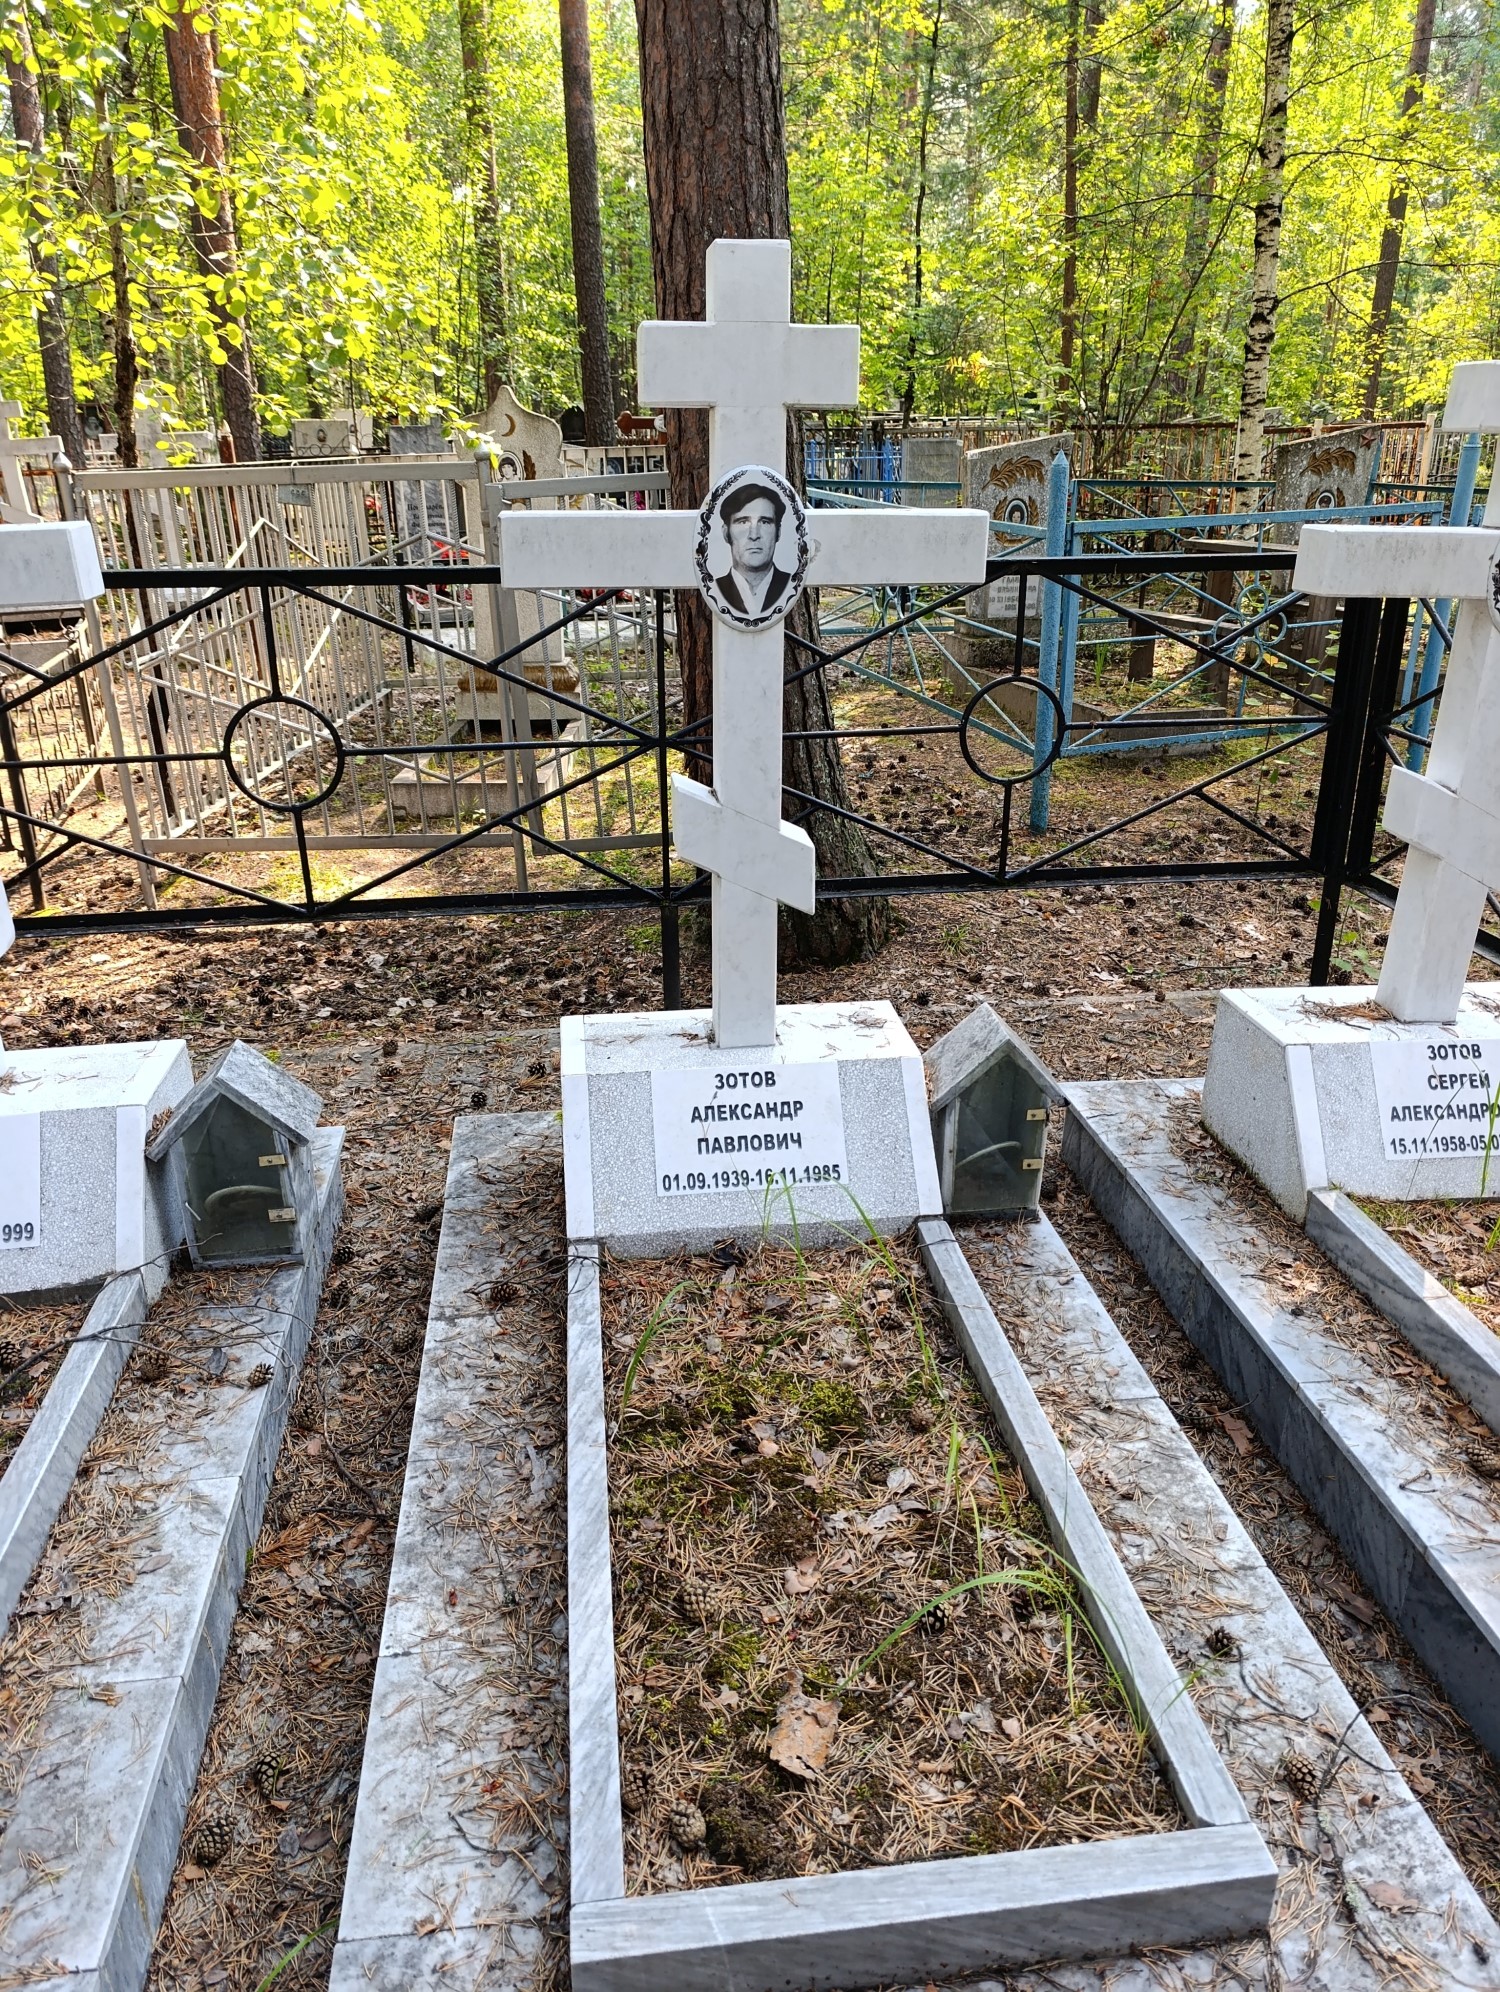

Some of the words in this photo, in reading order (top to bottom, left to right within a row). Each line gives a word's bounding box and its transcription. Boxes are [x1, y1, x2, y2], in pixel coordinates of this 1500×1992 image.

[1427, 1043, 1482, 1061] ЗОТОВ
[714, 1070, 776, 1090] ЗОТОВ
[1427, 1070, 1491, 1091] СЕРГЕЙ
[690, 1100, 804, 1123] АЛЕКСАНДР
[697, 1132, 802, 1155] ПАВЛОВИЧ
[1390, 1133, 1500, 1155] 15.11.1958-05.0
[662, 1163, 841, 1192] 01.09.1939-16.11.1985
